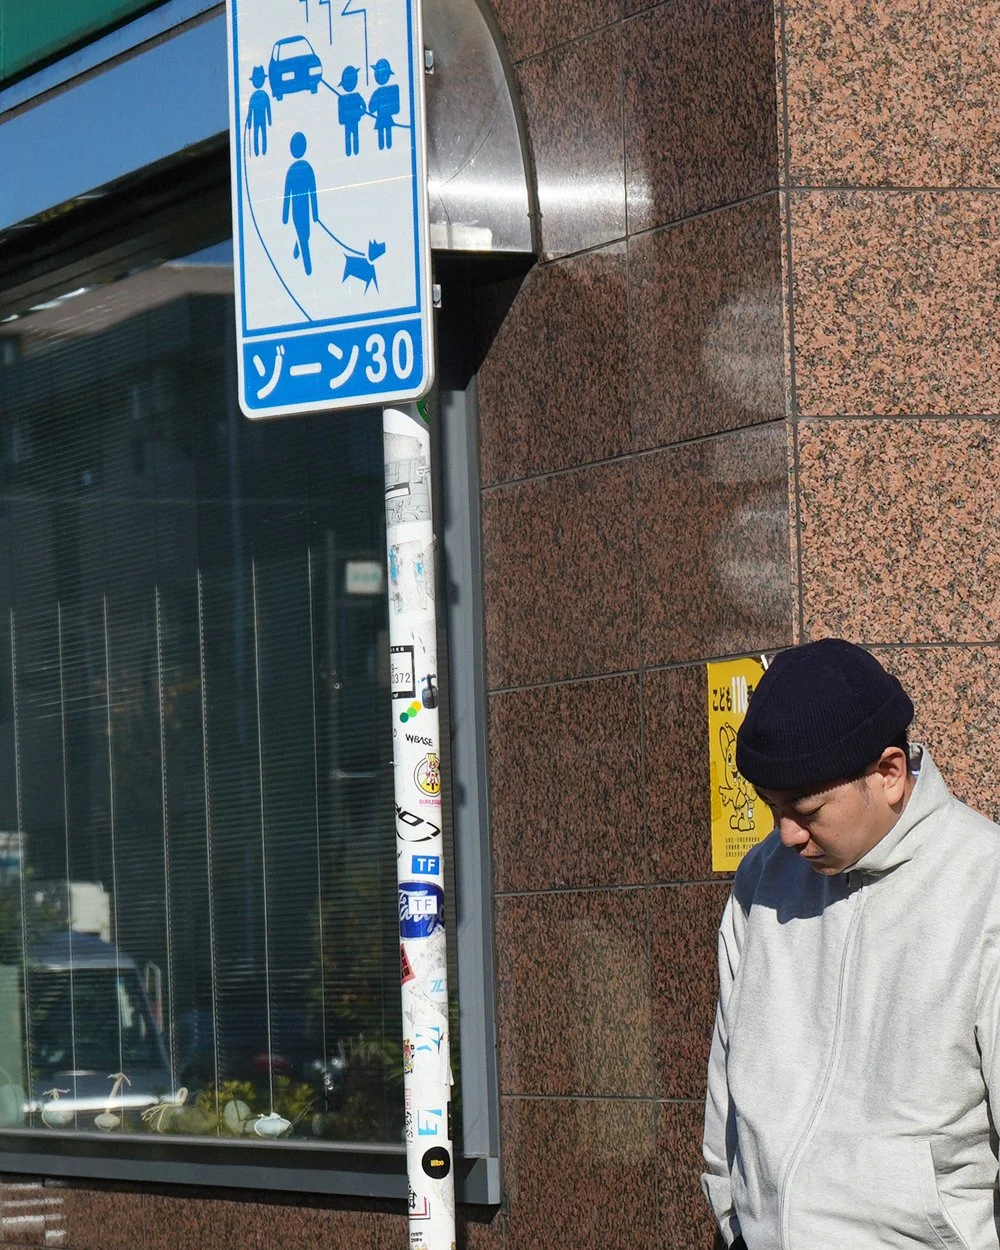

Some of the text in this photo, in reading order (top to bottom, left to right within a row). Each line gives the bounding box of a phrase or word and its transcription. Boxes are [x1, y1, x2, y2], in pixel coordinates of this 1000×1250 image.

[252, 329, 414, 400] ゾーン30
[417, 858, 436, 872] TF
[413, 899, 432, 912] TF
